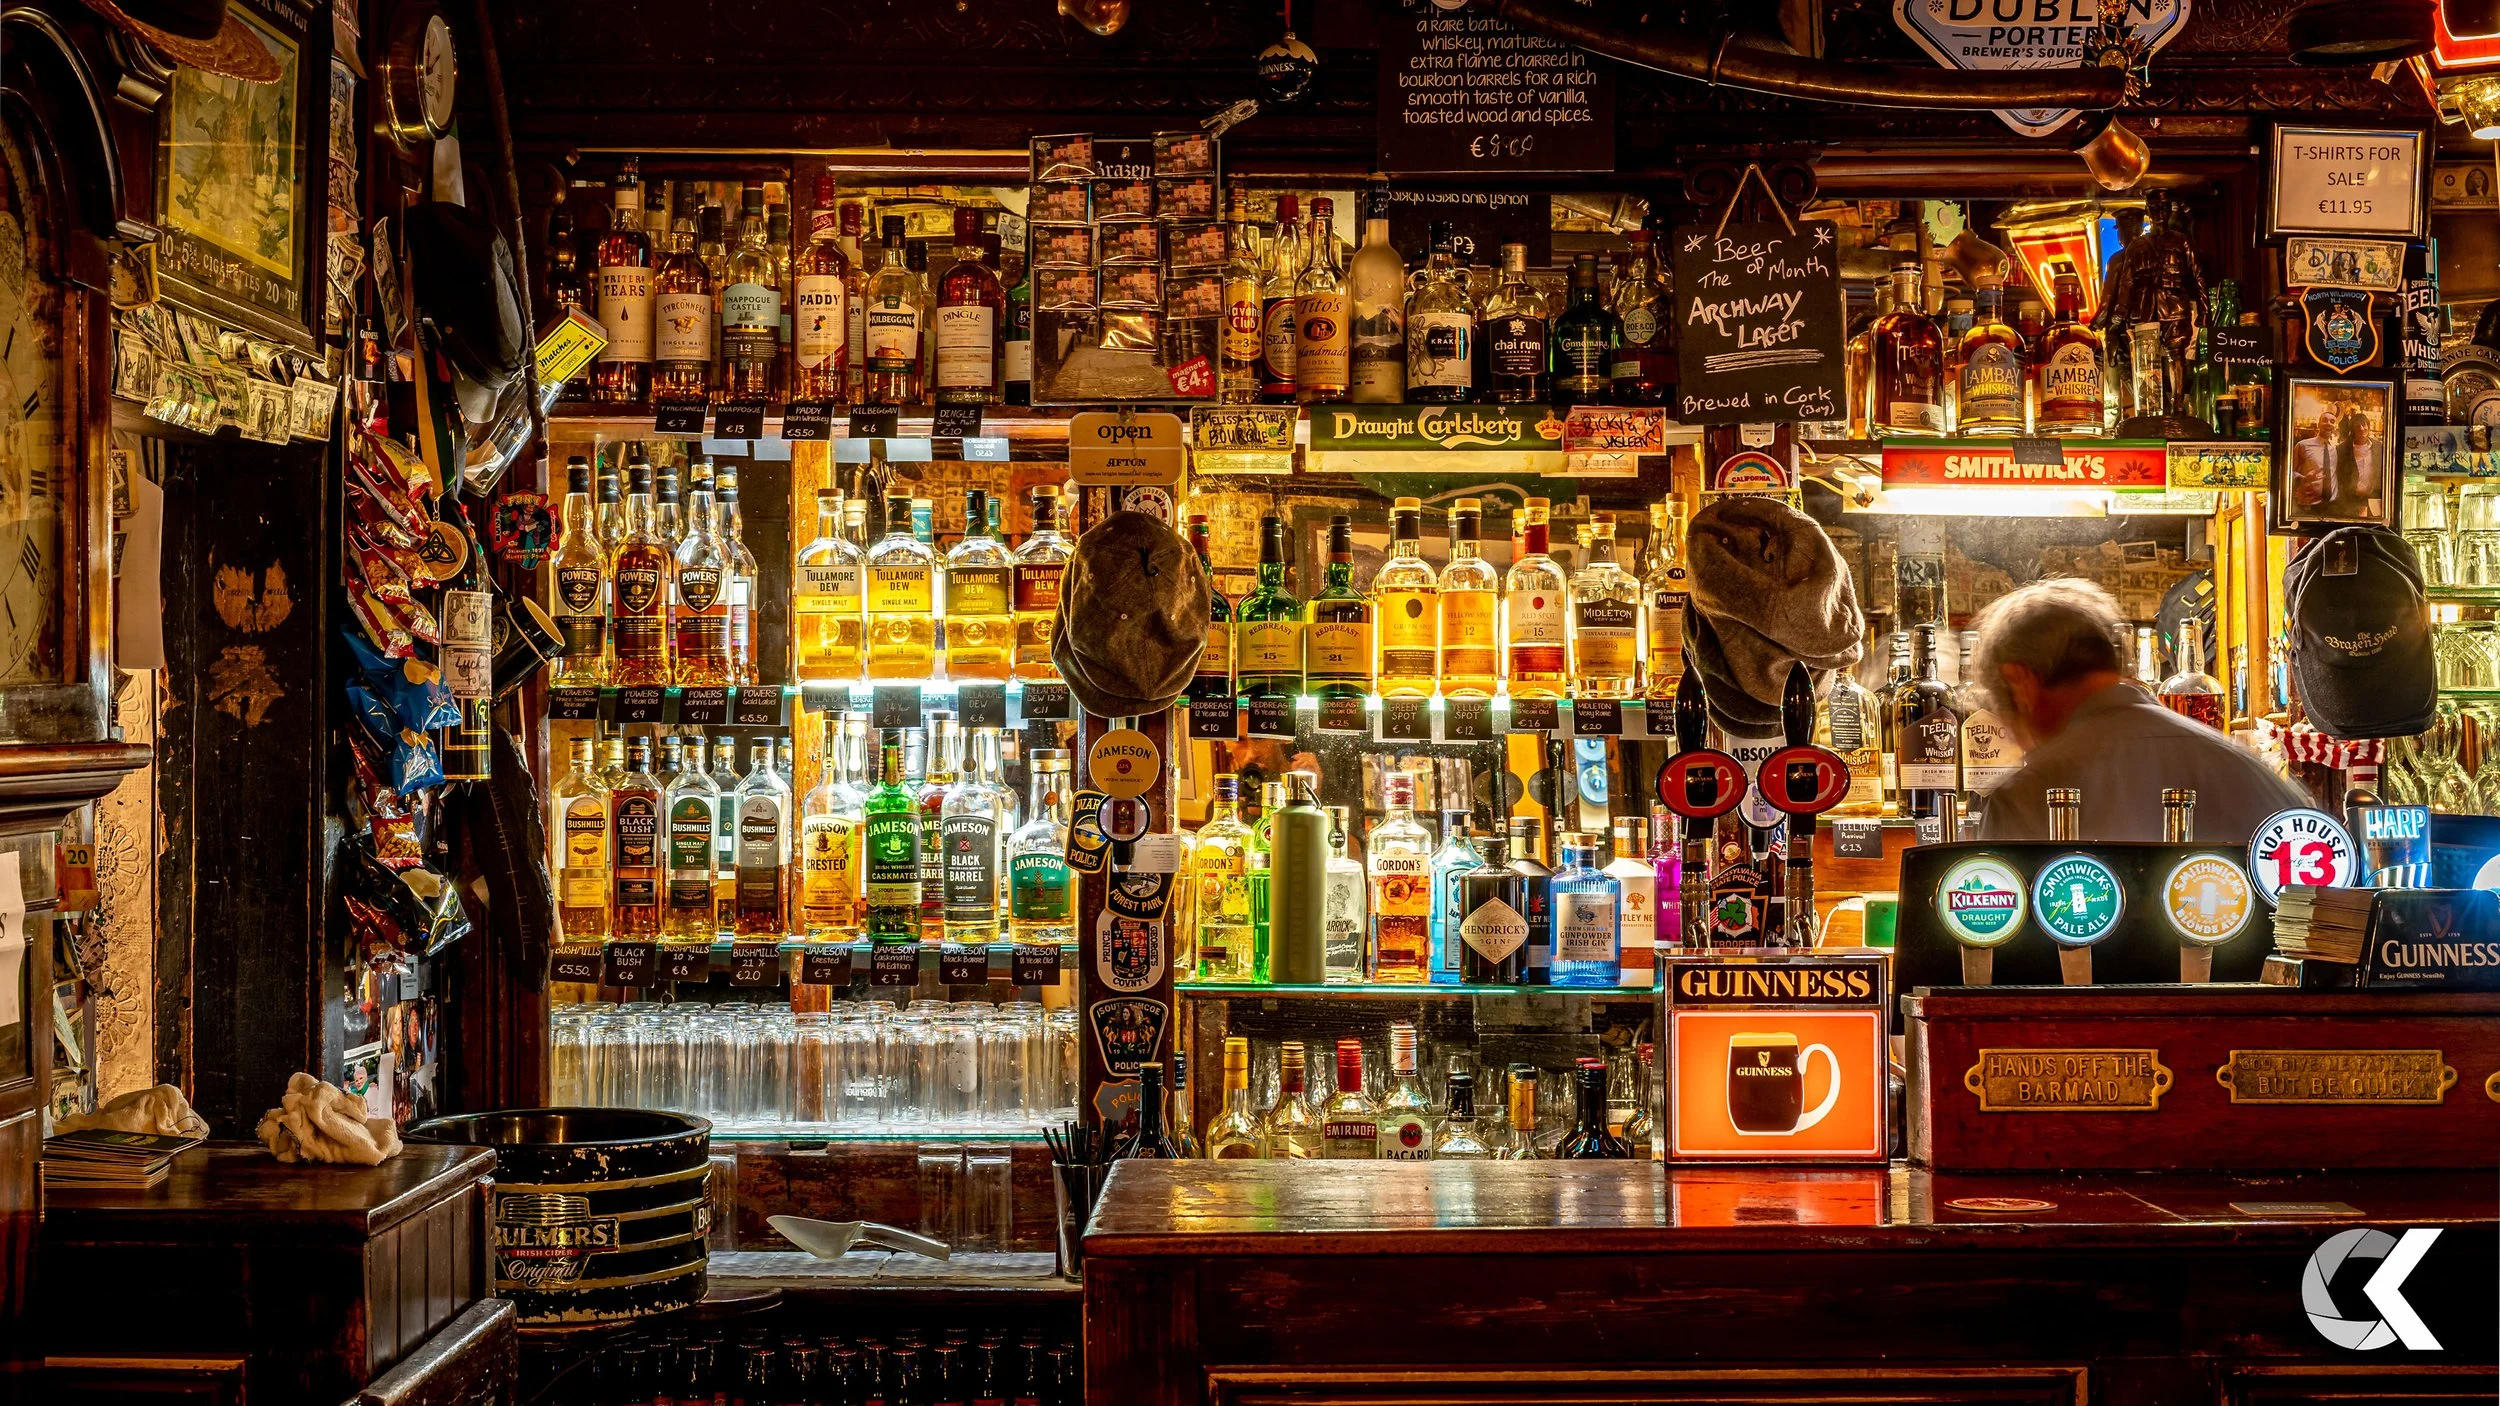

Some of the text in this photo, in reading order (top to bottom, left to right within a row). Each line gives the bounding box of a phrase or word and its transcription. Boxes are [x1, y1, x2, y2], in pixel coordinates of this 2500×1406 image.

[295, 15, 307, 32] CUT
[1417, 21, 1427, 32] a
[1422, 35, 1484, 55] whiskey,
[1457, 53, 1501, 67] flame
[1572, 52, 1585, 67] in
[1553, 75, 1562, 85] a
[1408, 89, 1534, 105] smooth taste of
[1403, 107, 1593, 126] toasted wood and spices.
[2294, 147, 2400, 160] T-SHIRTS FOR
[2328, 173, 2365, 185] SALE
[2319, 200, 2372, 214] €11.95
[1713, 238, 1782, 262] Beer
[1698, 256, 1829, 288] The Month
[604, 285, 645, 297] TEARS
[800, 295, 840, 305] PADDY
[663, 302, 706, 315] TYRCONNELL
[1299, 298, 1342, 315] Tito's
[871, 314, 913, 325] KILBEGGAN
[943, 310, 981, 322] DINGLE
[1688, 291, 1802, 337] ARCHWAY
[1232, 317, 1256, 330] Club
[1266, 334, 1287, 345] SEA
[1298, 344, 1347, 358] Handmade
[1495, 341, 1541, 351] chai rum
[2328, 355, 2359, 365] POLICE
[1965, 368, 2020, 388] LAMBAY
[2046, 368, 2101, 388] LAMBAY
[1972, 383, 2014, 396] WHISKEY
[2055, 384, 2096, 396] WHISKEY
[1683, 386, 1831, 414] Brewed in Cork
[796, 406, 822, 414] PADDY
[852, 407, 897, 415] KILBEGGAN
[940, 410, 975, 419] DINGLE
[1332, 408, 1522, 448] Draught Carlsberg
[1098, 425, 1152, 444] open
[1209, 428, 1268, 446] BOURQUE
[1106, 458, 1146, 467] AFTON
[1943, 455, 2106, 480] SMITHWICK'S
[1731, 475, 1771, 483] CALIFORNIA
[562, 571, 597, 582] POWERS
[620, 572, 656, 582] POWERS
[682, 572, 718, 582] POWERS
[805, 570, 854, 581] TULLAMORE
[875, 569, 924, 580] TULLAMORE
[951, 573, 999, 584] TULLAMORE
[820, 583, 839, 591] DEW
[890, 582, 910, 590] DEW
[965, 585, 984, 594] DEW
[1034, 581, 1054, 589] DEW
[1584, 608, 1632, 619] MIDLETON
[1248, 623, 1294, 637] REDBREAST
[1315, 624, 1360, 638] REDBREAST
[1533, 627, 1544, 637] 15
[1264, 652, 1276, 660] 15
[1329, 654, 1342, 662] 21
[743, 690, 776, 698] POWERS
[1191, 702, 1233, 710] REDBREAST
[1388, 704, 1418, 712] GREEN
[563, 710, 579, 719] €9
[632, 710, 645, 719] €9
[692, 711, 709, 720] €11
[1391, 711, 1416, 721] SPOT
[1201, 724, 1219, 732] €10
[1097, 746, 1152, 760] JAMESON
[1925, 748, 1954, 758] WHISKEY
[1969, 749, 2000, 758] WHISKEY
[567, 820, 605, 829] BUSHMILLS
[672, 823, 710, 832] BUSHMILLS
[742, 825, 775, 833] BUSHMILLS
[868, 821, 919, 836] JAMESON
[2366, 808, 2426, 839] HARP
[803, 823, 848, 836] JAMESON
[944, 823, 988, 836] JAMESON
[2259, 818, 2346, 861] HOP HOUSE
[1841, 843, 1862, 852] €13
[67, 849, 88, 865] 20
[685, 855, 694, 863] 10
[755, 856, 763, 865] 21
[951, 855, 979, 866] BLACK
[1070, 849, 1098, 866] POLICE
[806, 859, 846, 871] CRESTED
[1015, 857, 1063, 871] JAMESON
[1377, 858, 1421, 871] GORDON'S
[2269, 841, 2336, 886] 13
[872, 872, 917, 880] CASKMATES
[949, 870, 983, 881] BARREL
[1732, 876, 1759, 887] POLICE
[1951, 893, 2015, 908] KILKENNY
[1962, 913, 2006, 922] DRAUGHT
[1465, 925, 1526, 935] HENDRICK'S
[2054, 916, 2085, 934] PALE
[1566, 939, 1605, 947] IRISH GIN
[614, 948, 645, 957] BLACK
[732, 948, 779, 957] BUSHMILLS
[805, 947, 847, 955] JAMESON
[874, 946, 915, 954] JAMESON
[944, 946, 986, 955] JAMESON
[1016, 947, 1057, 956] JAMESON
[2381, 940, 2500, 968] GUINNESS
[617, 957, 641, 966] BUSH
[812, 956, 839, 964] Crested
[619, 971, 633, 980] €6
[672, 965, 688, 975] €8
[736, 970, 760, 980] €20
[951, 968, 968, 978] €8
[1681, 970, 1870, 997] GUINNESS
[1736, 1066, 1792, 1076] GUINNESS
[1990, 1056, 2149, 1077] HANDS OFF THE
[2259, 1076, 2414, 1095] BUT BE QUICK
[2019, 1081, 2119, 1102] BARMAID
[1326, 1125, 1375, 1136] SMIRNOFF
[495, 1224, 608, 1246] BULMERS
[509, 1260, 578, 1287] Original
